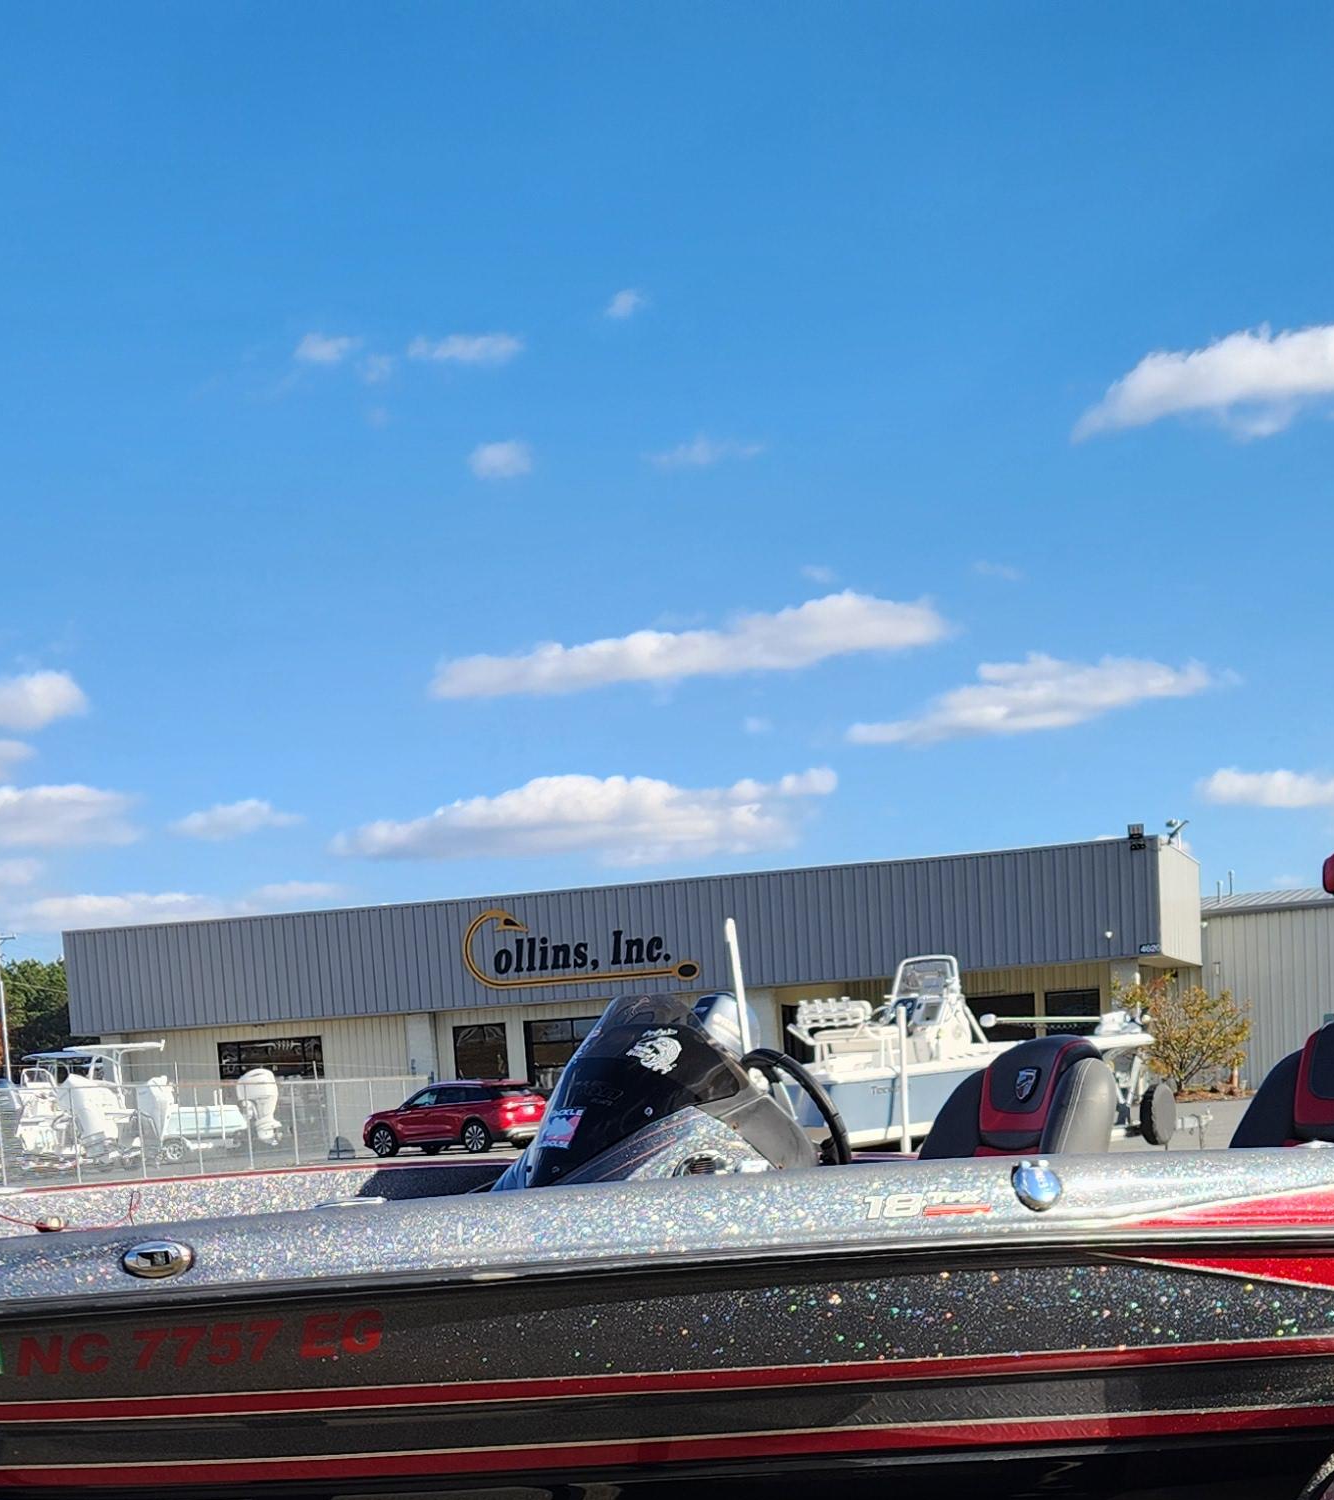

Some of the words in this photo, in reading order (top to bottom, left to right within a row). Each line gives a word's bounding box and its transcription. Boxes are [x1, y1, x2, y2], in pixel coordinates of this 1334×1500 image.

[611, 929, 672, 966] Inc.
[17, 1333, 111, 1376] NC
[131, 1319, 283, 1371] 7757
[299, 1309, 384, 1359] EG
